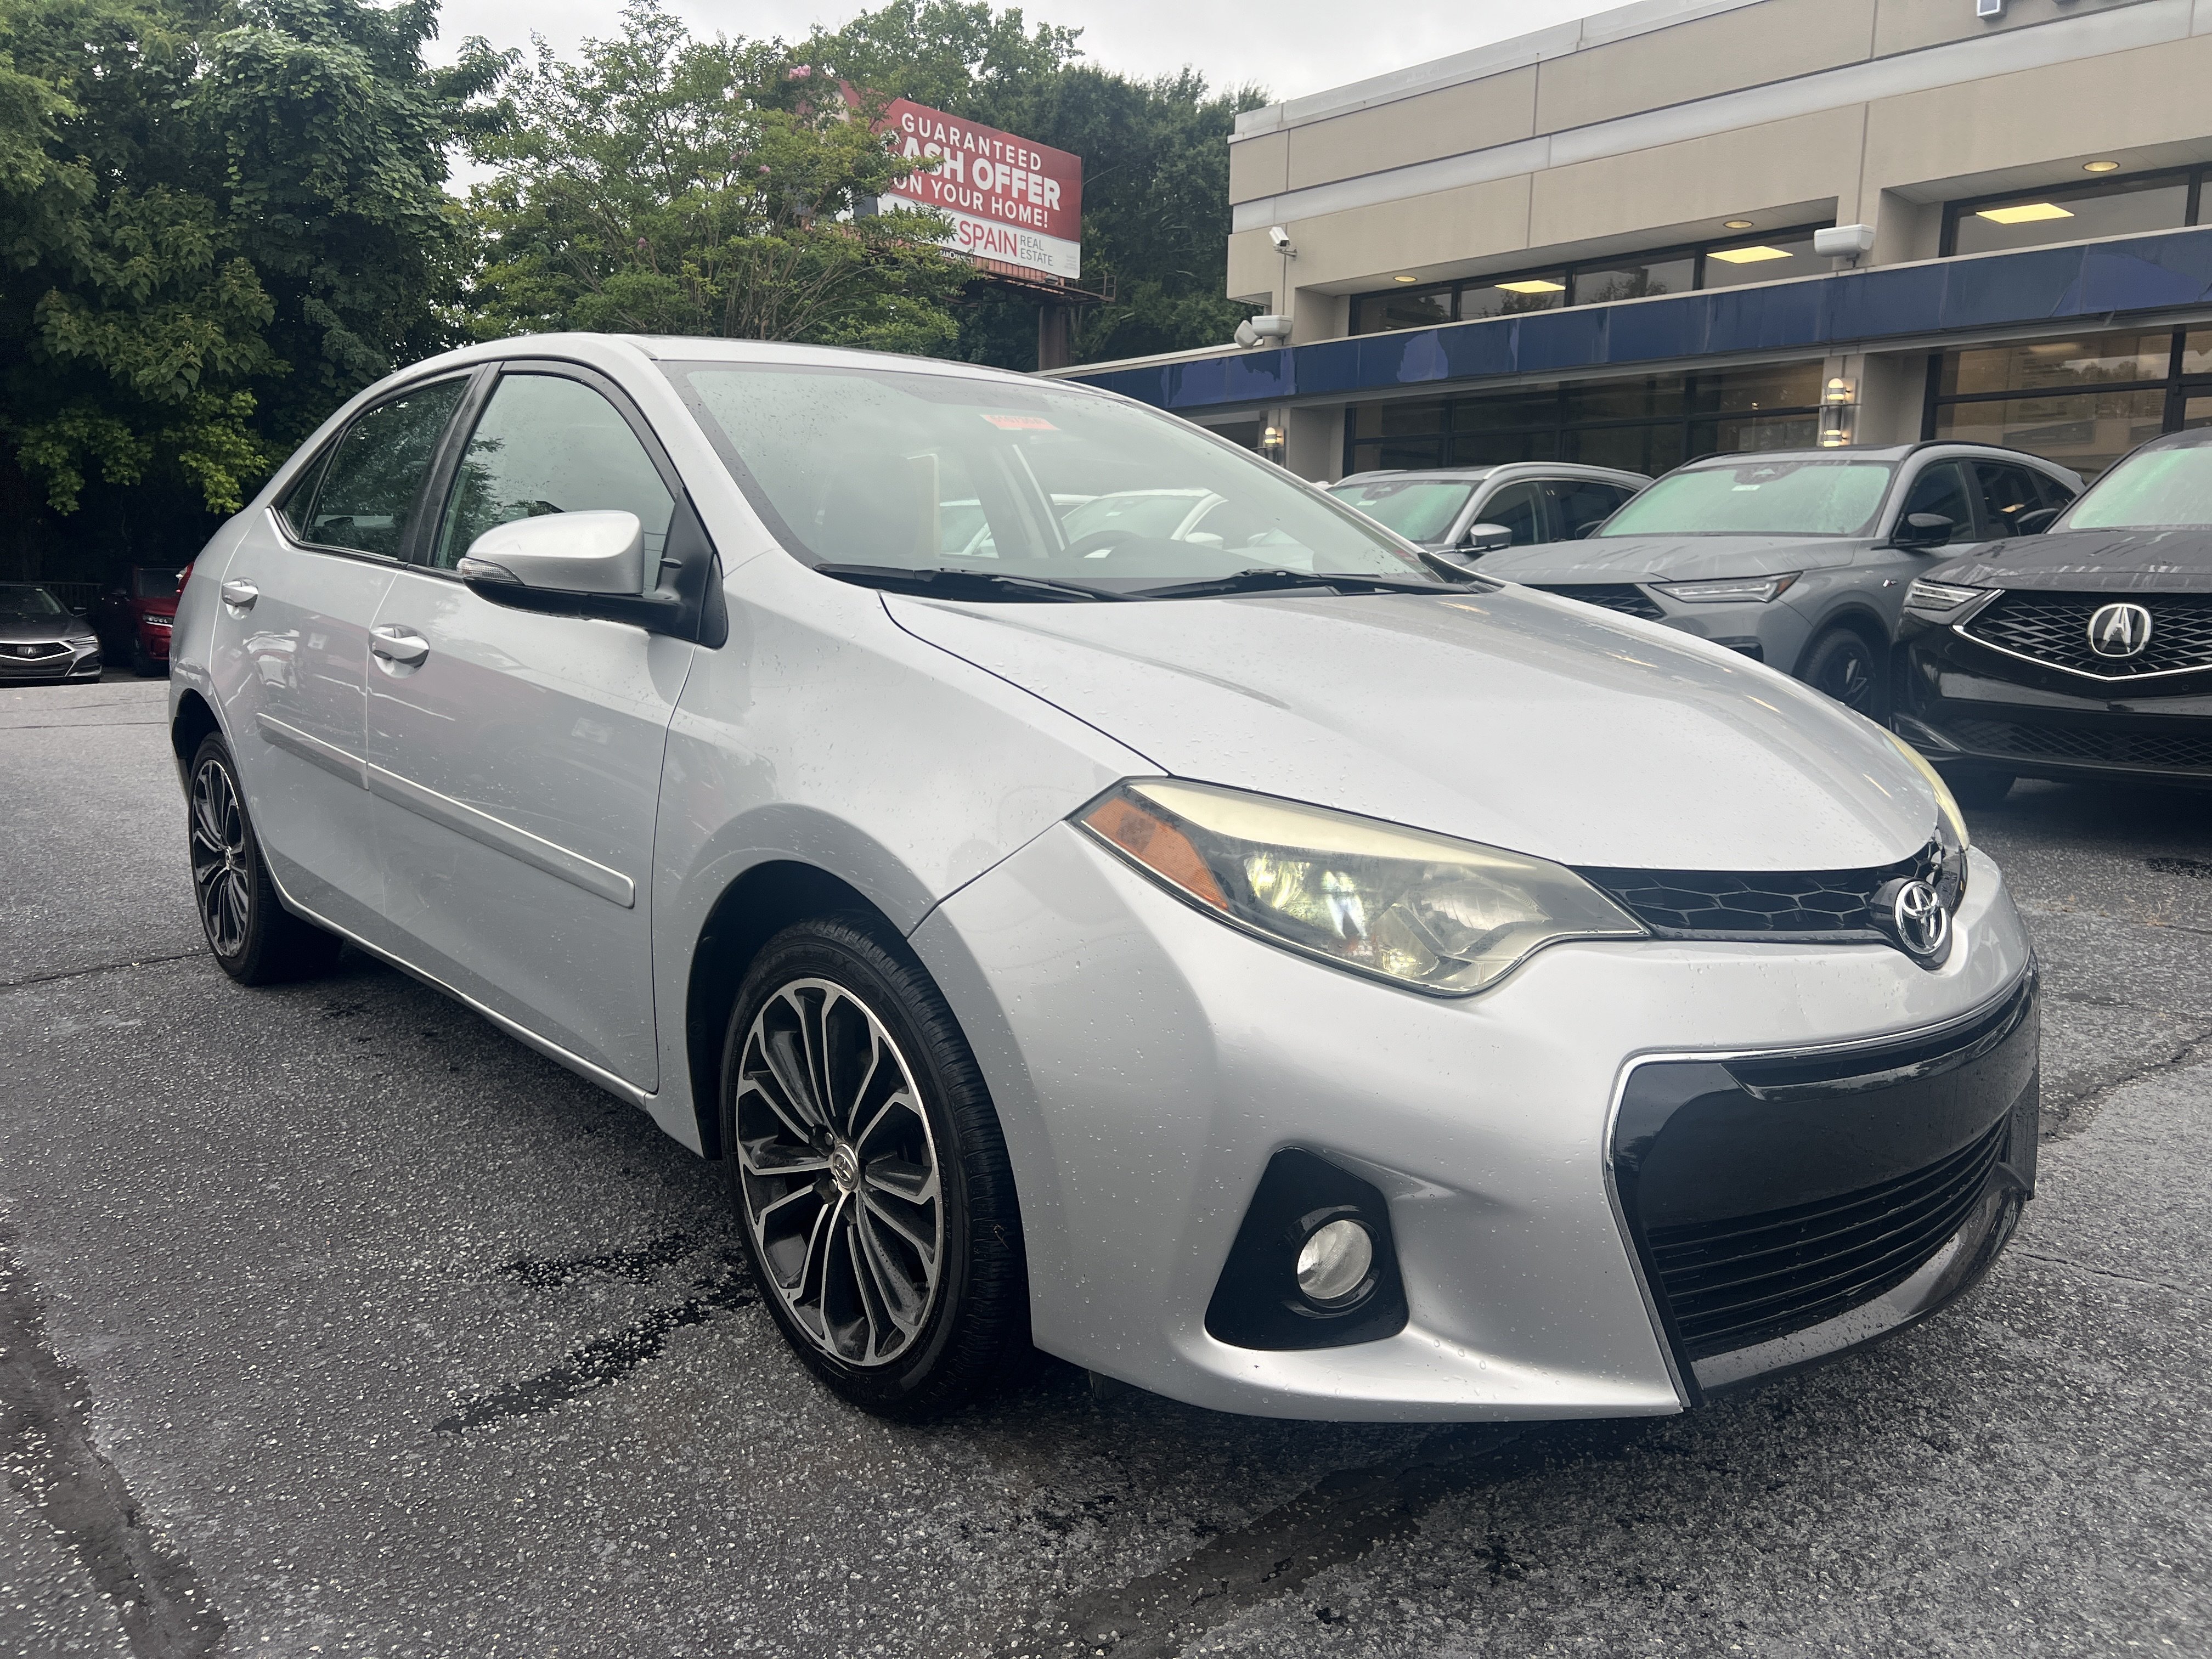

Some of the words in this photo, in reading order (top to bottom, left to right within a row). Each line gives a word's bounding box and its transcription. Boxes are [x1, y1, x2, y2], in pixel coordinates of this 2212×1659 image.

[901, 112, 1042, 171] GUARANTEED
[879, 130, 964, 183] ASH
[972, 157, 1061, 211] OFFER
[930, 179, 984, 211] YOUR
[991, 196, 1048, 228] HOME!
[958, 220, 1018, 257] SPAIN
[1020, 235, 1045, 251] REAL
[1020, 248, 1054, 266] ESTATE
